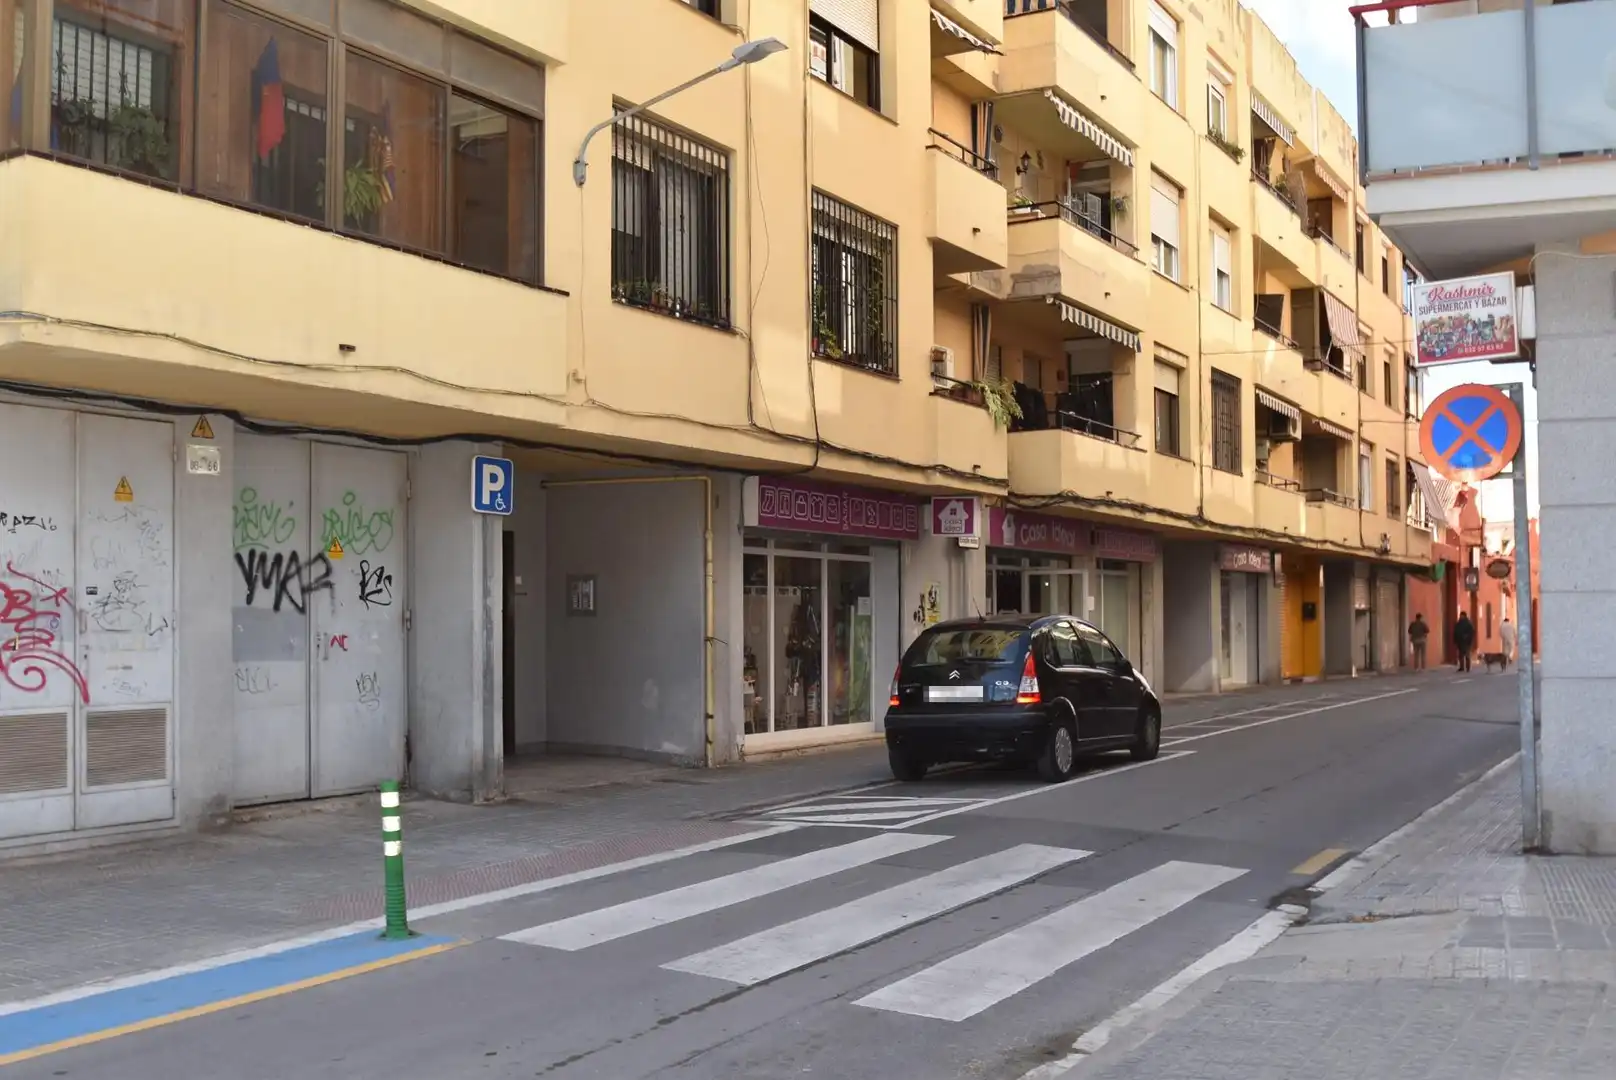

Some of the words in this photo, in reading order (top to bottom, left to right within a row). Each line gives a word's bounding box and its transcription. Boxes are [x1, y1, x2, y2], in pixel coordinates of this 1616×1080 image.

[1419, 299, 1473, 316] SUPERMERCAT
[1474, 299, 1480, 309] Y
[1482, 296, 1507, 308] BAZAR
[482, 463, 505, 505] P
[1020, 524, 1047, 545] Casa
[1233, 552, 1247, 569] Casa
